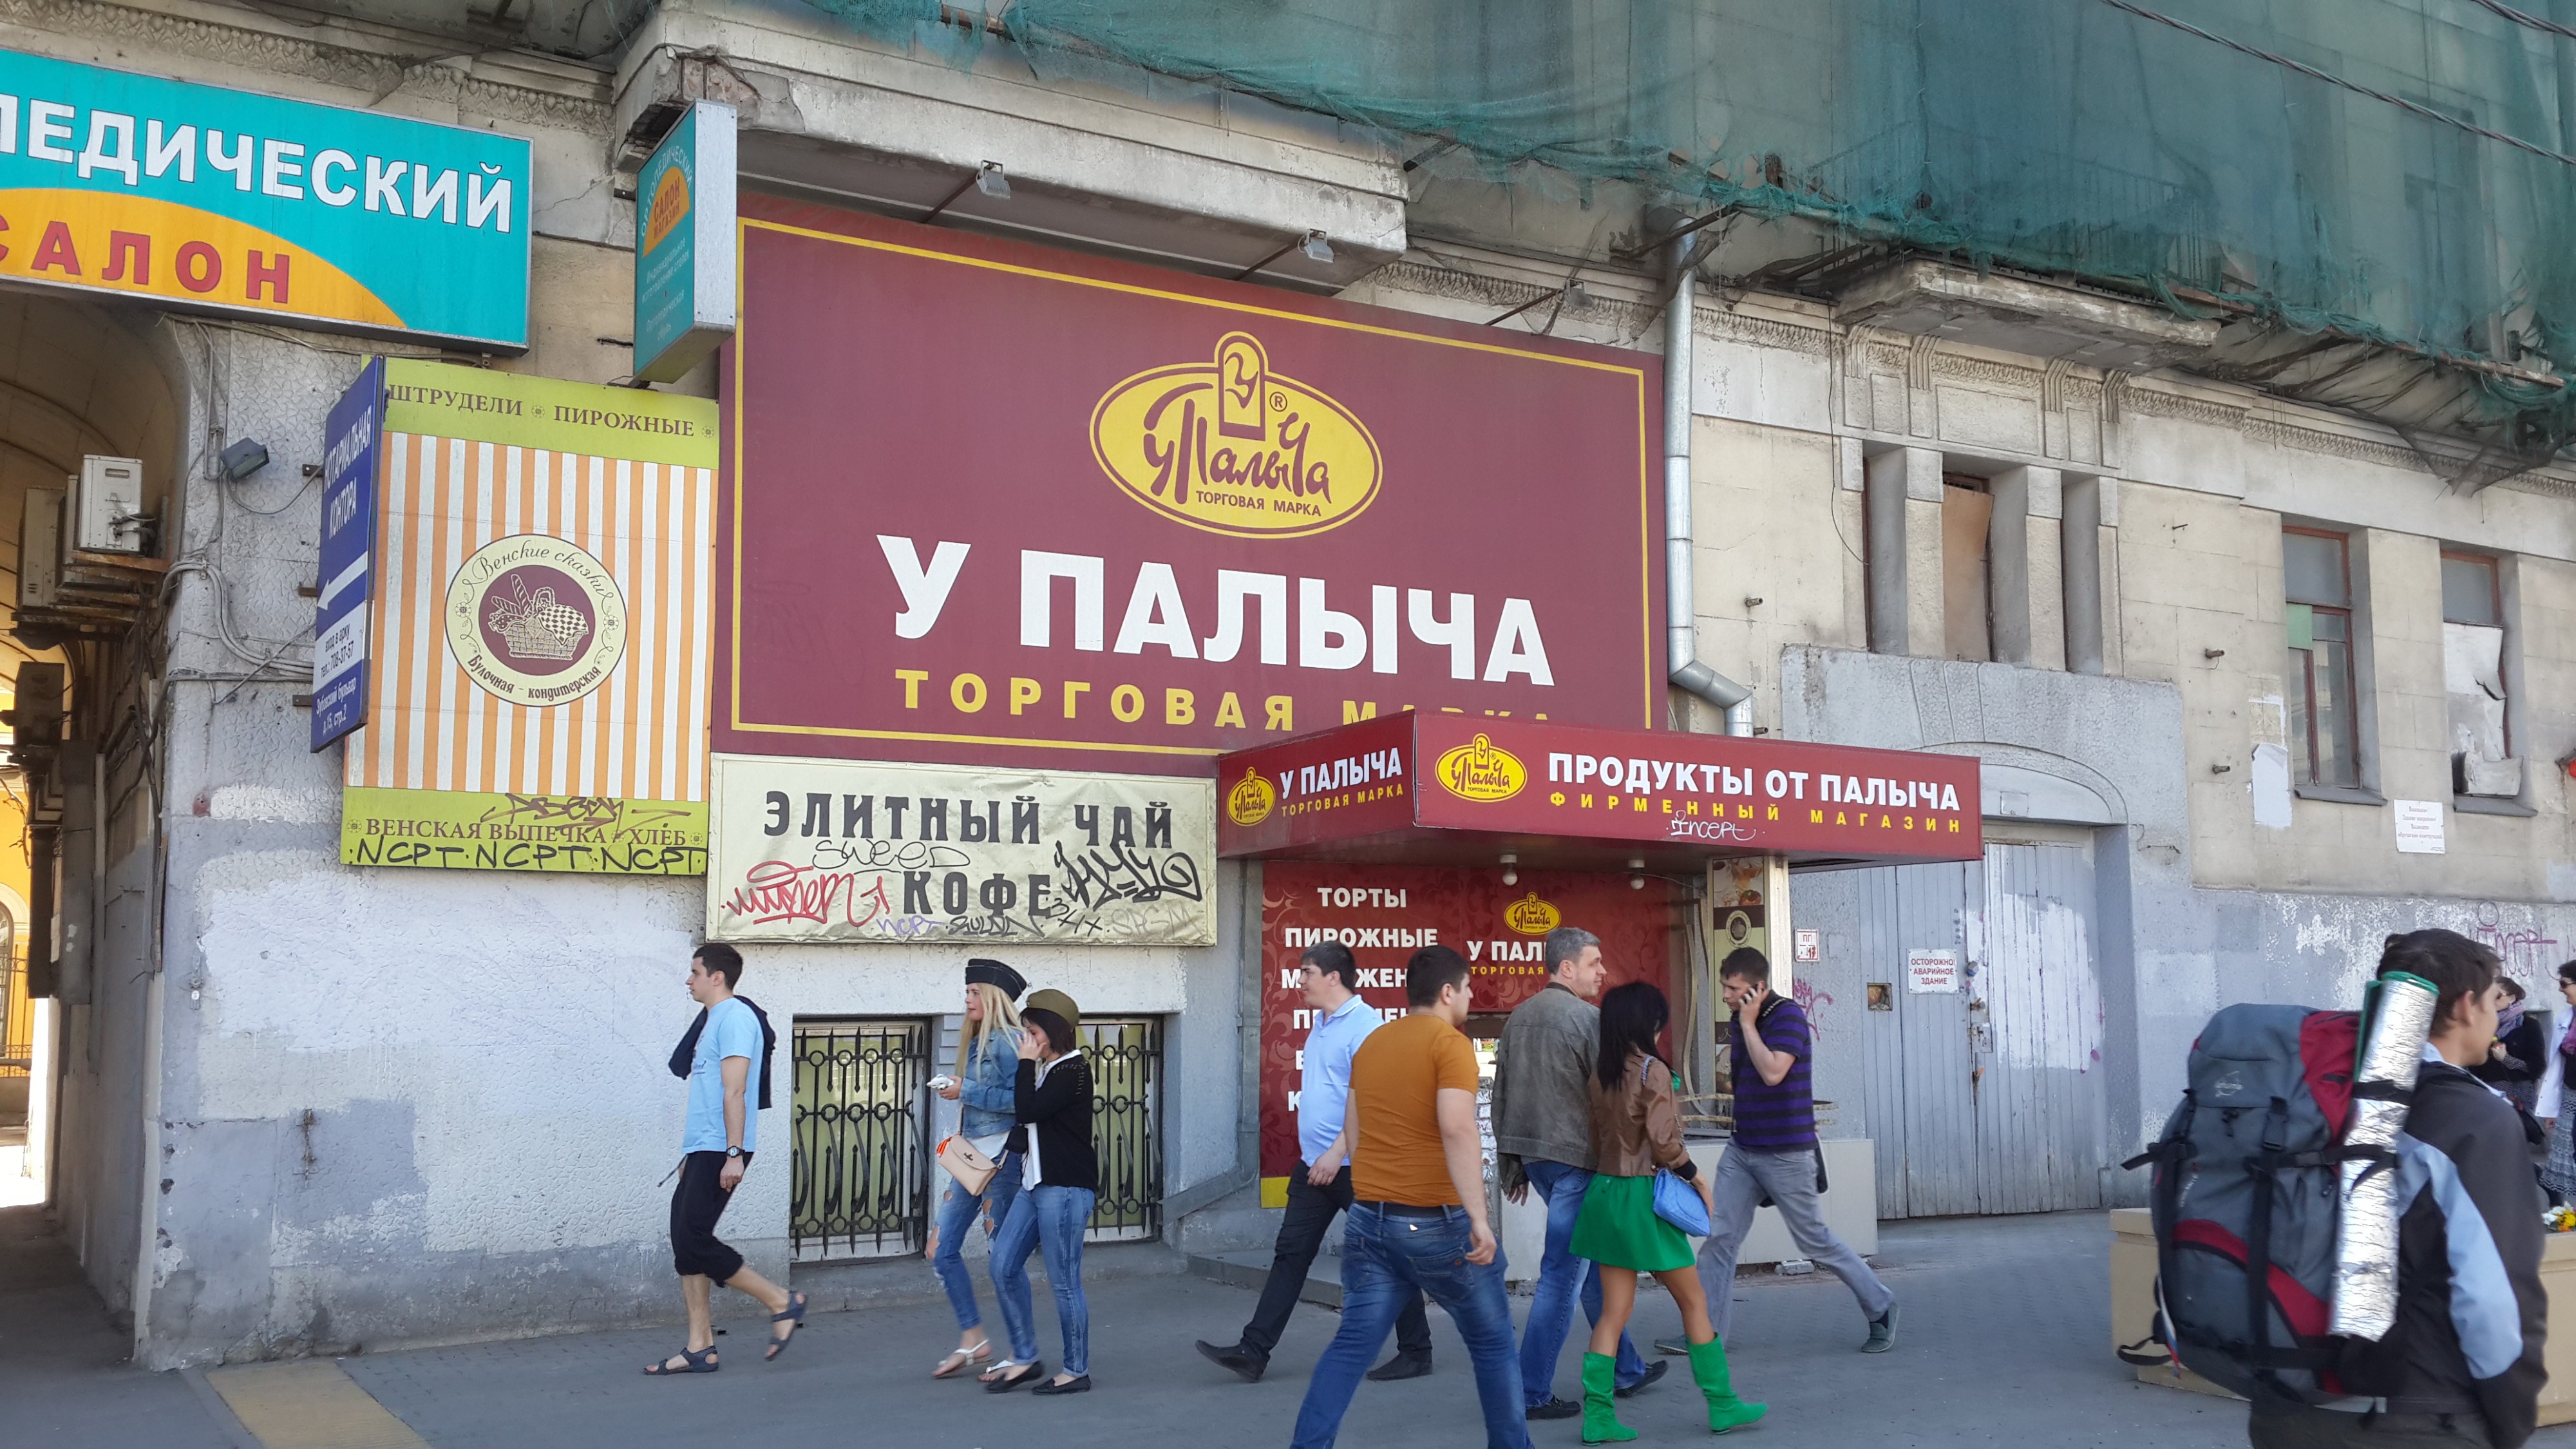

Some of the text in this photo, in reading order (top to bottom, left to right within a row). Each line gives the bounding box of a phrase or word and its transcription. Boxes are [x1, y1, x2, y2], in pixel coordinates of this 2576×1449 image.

[641, 145, 693, 237] ОРТОПЕДИЧЕСКИЙ
[654, 176, 681, 223] САЛОН
[653, 201, 680, 240] МАГАЗИН
[0, 214, 290, 304] АЛОН
[388, 384, 694, 437] ШТРУДЕЛИ ПИРОЖНЫЕ
[324, 404, 372, 495] НОТАРИАЛЬНАЯ
[328, 477, 357, 540] КОНТОРА
[1196, 490, 1321, 517] ТОРГОВАЯ МАРКА
[470, 540, 609, 594] Венские сказки
[876, 534, 1555, 687] У ПАЛЫЧА
[467, 654, 602, 702] Булочная кондитерская
[895, 668, 1293, 732] ТОРГОВАЯ
[1280, 746, 1403, 800] У ПАЛЫЧА
[1548, 752, 1961, 811] ПРОДУКТЫ ОТ ПАЛЫЧА
[764, 791, 1172, 848] ЭЛИТНЫЙ ЧАЙ
[1282, 783, 1404, 817] ТОРГОВАЯ МАРКА
[1549, 791, 1960, 833] ФИРМЕННЫЙ МАГАЗИН
[365, 818, 482, 840] ВЕНСКАЯ
[488, 824, 607, 844] ВЫПЕЧКА
[904, 870, 1051, 916] КОФЕ
[1317, 887, 1407, 908] ТОРТЫ
[1285, 927, 1439, 947] ПИРОЖНЫЕ
[1466, 940, 1547, 961] У ПАЛ
[1803, 934, 1812, 942] ПГ
[1470, 966, 1544, 975] ТОРГОВАЯ
[1913, 967, 1955, 975] АВАРИЙНОЕ
